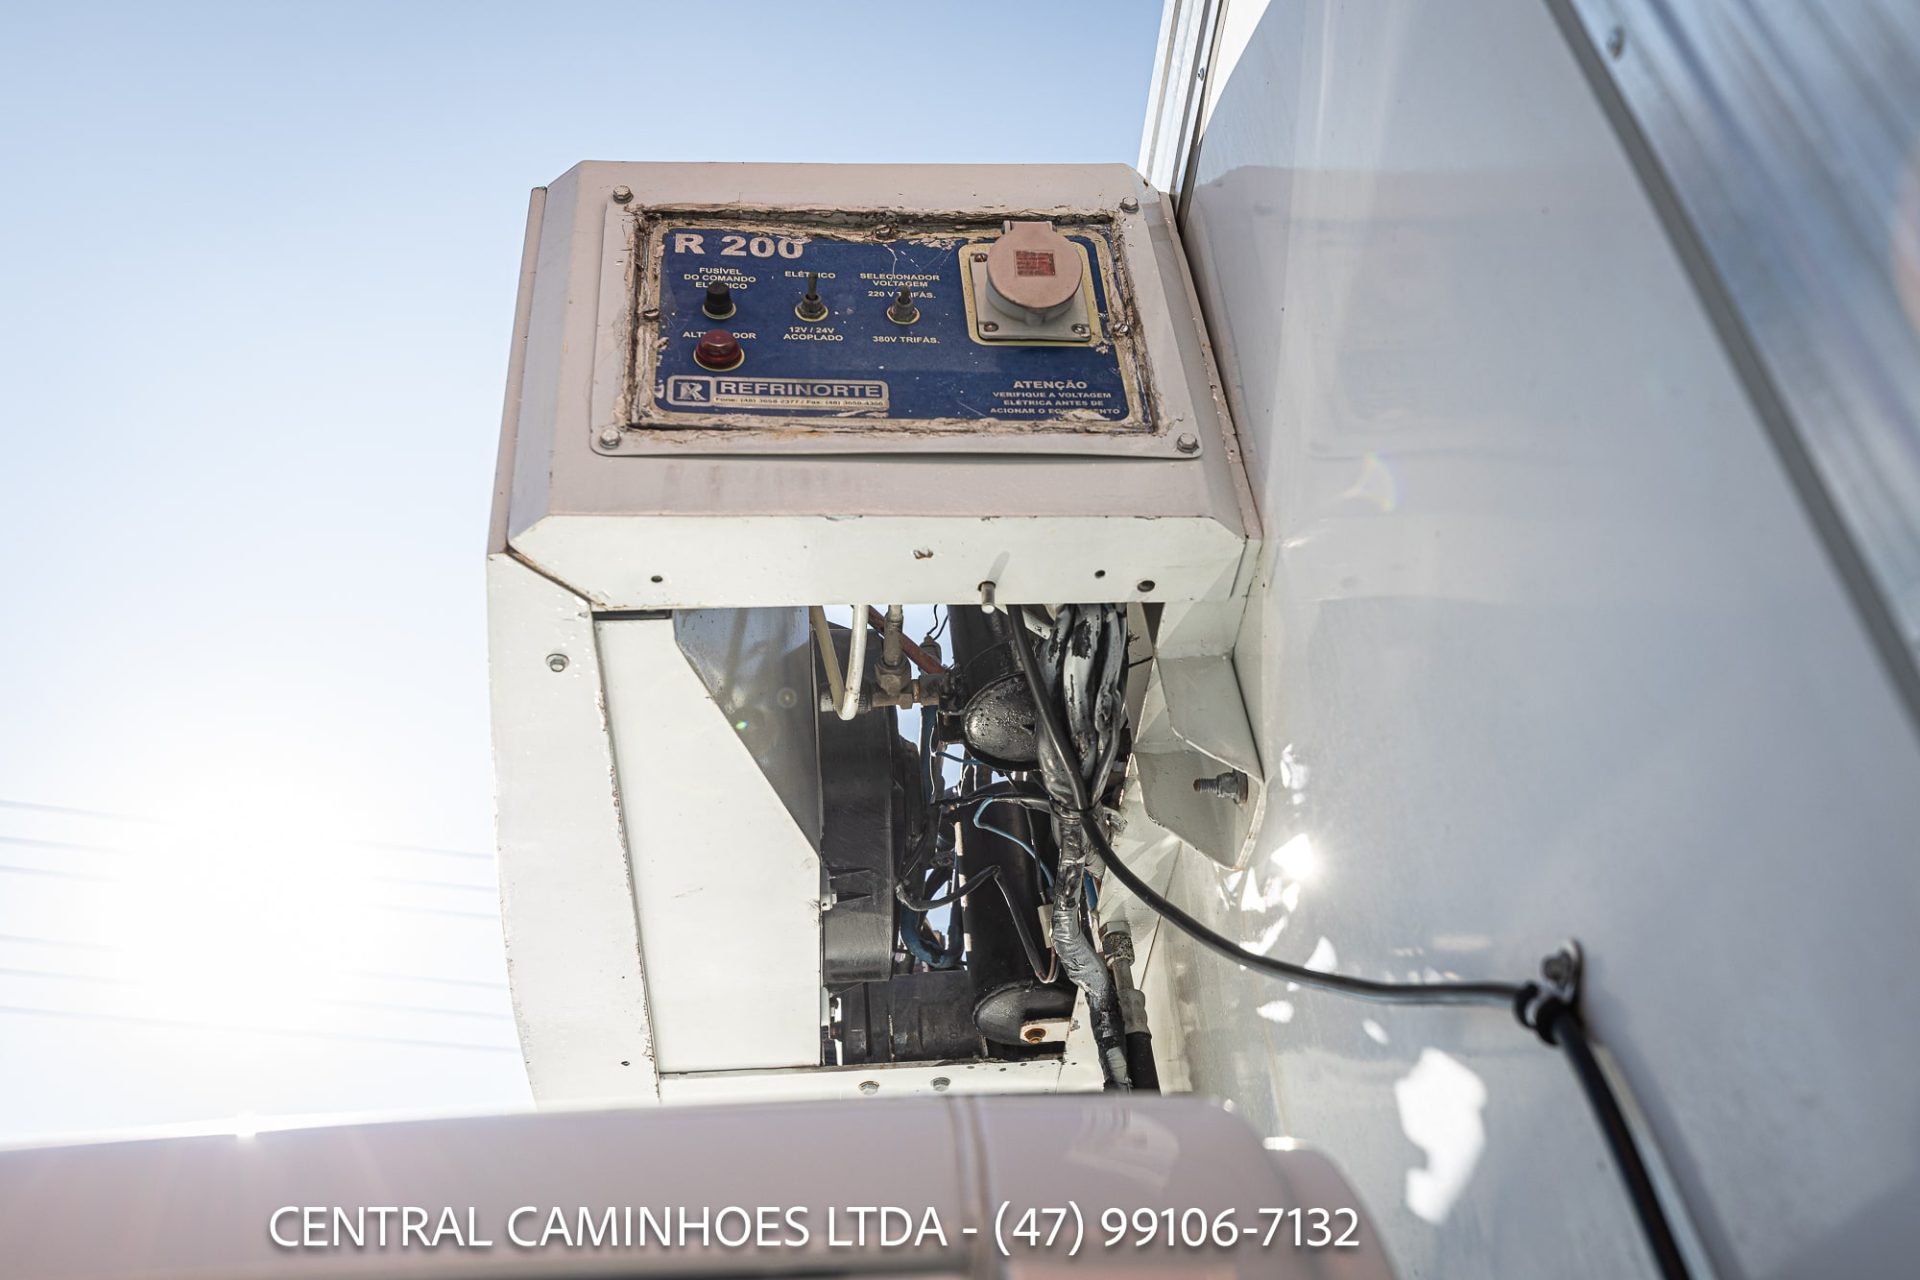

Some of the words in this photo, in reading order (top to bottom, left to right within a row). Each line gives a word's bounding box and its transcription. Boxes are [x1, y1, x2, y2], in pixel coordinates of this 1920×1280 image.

[675, 233, 705, 255] R
[720, 235, 804, 259] 200
[699, 267, 743, 275] FUSÍVEL
[784, 270, 836, 279] ELÉTICO
[702, 274, 757, 283] COMANDO
[859, 272, 940, 281] SELECIONADOR
[872, 280, 928, 288] VOLTAGEM
[783, 333, 844, 341] ACOPLADO
[720, 381, 881, 397] REFRINORTE
[1013, 379, 1088, 391] ATENÇÃO
[1058, 391, 1112, 399] VOLTAGEM
